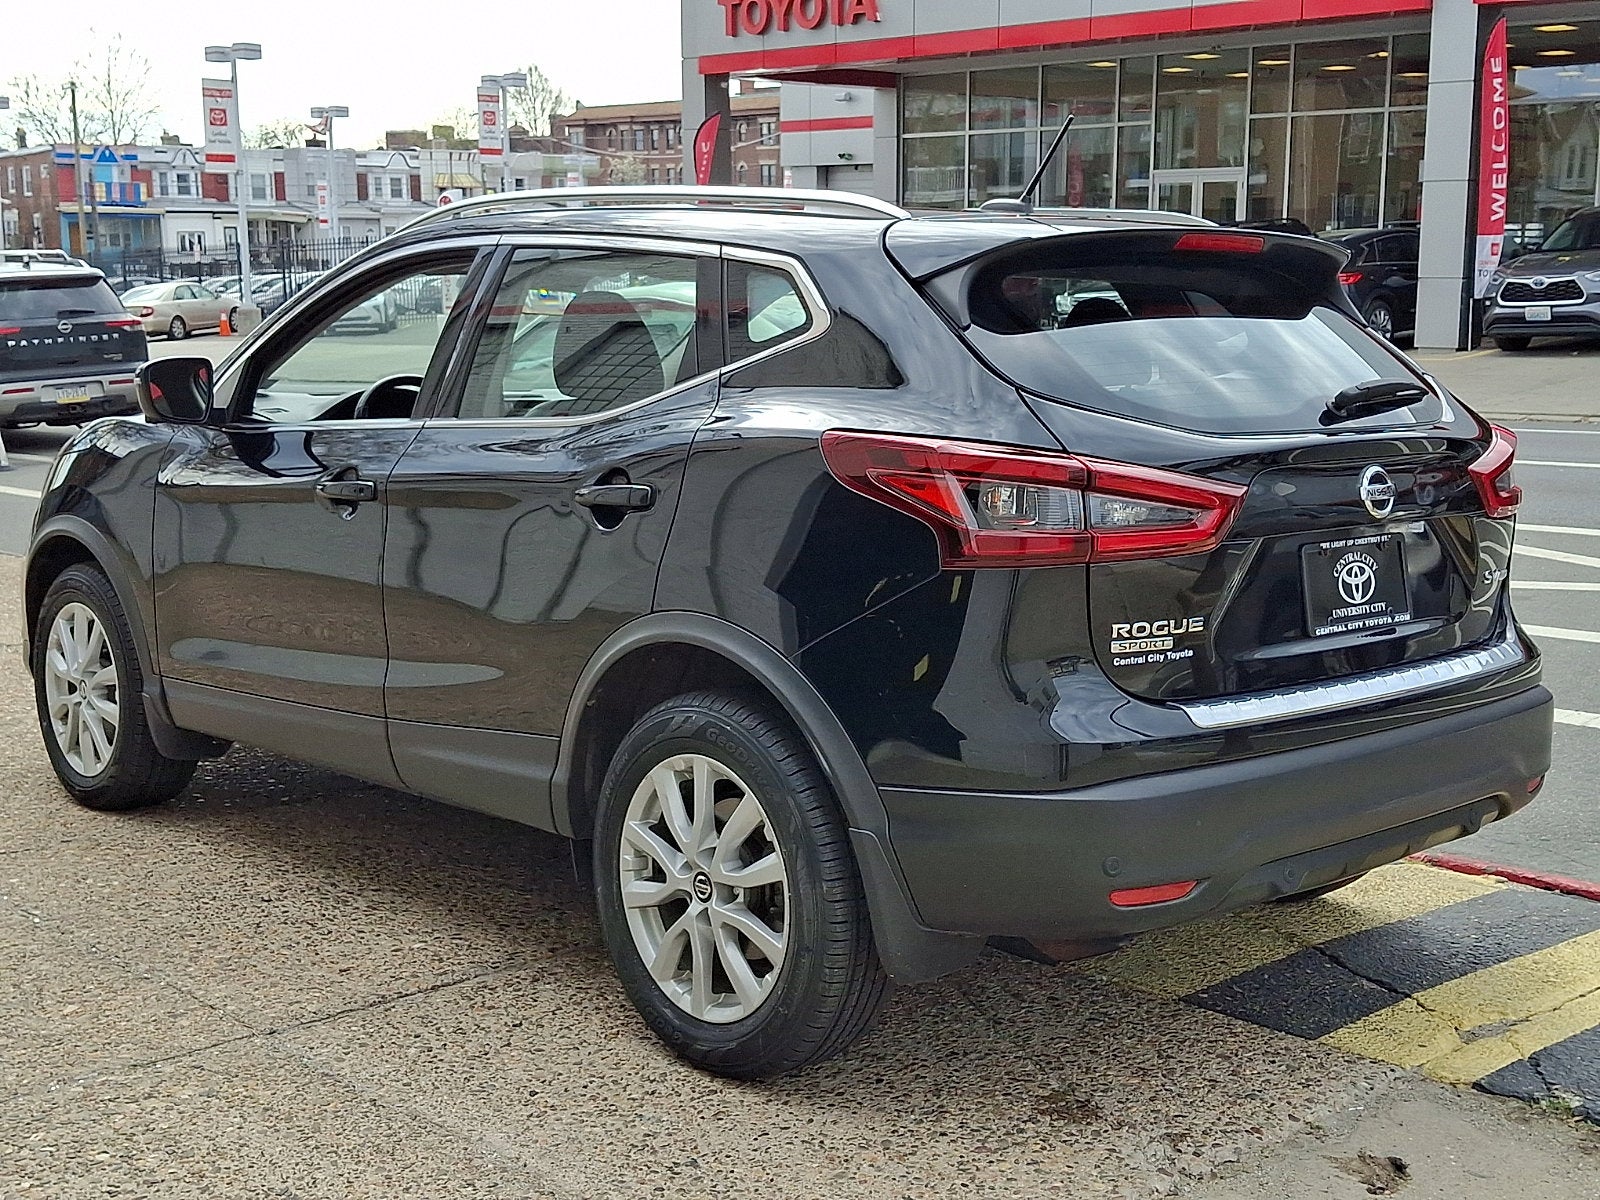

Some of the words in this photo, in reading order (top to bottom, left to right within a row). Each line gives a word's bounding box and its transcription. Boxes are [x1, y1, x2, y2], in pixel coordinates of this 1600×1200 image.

[1490, 56, 1507, 222] WELCOME
[7, 332, 120, 347] PATHFINDER
[1331, 540, 1346, 548] LIGHT
[1333, 552, 1361, 577] CENTRAL
[1362, 553, 1379, 571] CITY
[1332, 605, 1370, 618] UNIVERSITY
[1370, 602, 1387, 612] CITY
[1112, 617, 1204, 638] ROGUE
[1315, 624, 1347, 636] CENTRAL
[1347, 621, 1364, 630] CITY
[1365, 616, 1393, 627] TOYOTA
[1118, 640, 1167, 651] SPORT
[1113, 655, 1146, 666] Central
[1147, 653, 1165, 663] City
[1166, 648, 1194, 660] Toyota
